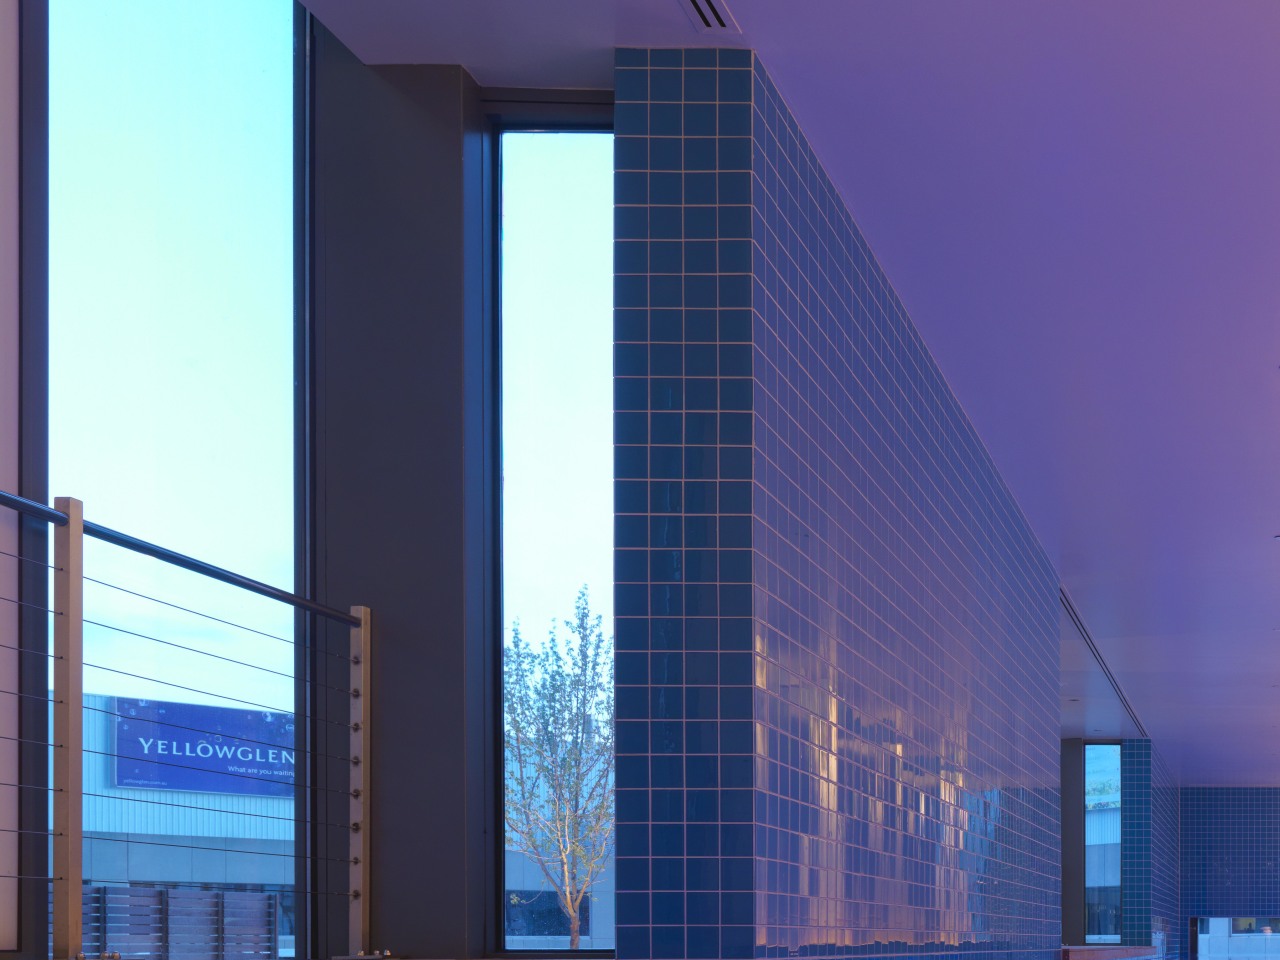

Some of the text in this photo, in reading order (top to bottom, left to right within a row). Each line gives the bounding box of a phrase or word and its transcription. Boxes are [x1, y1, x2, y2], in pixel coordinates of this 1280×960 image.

[138, 737, 295, 765] YELLOWGLEN
[228, 765, 246, 773] What
[259, 768, 272, 776] you
